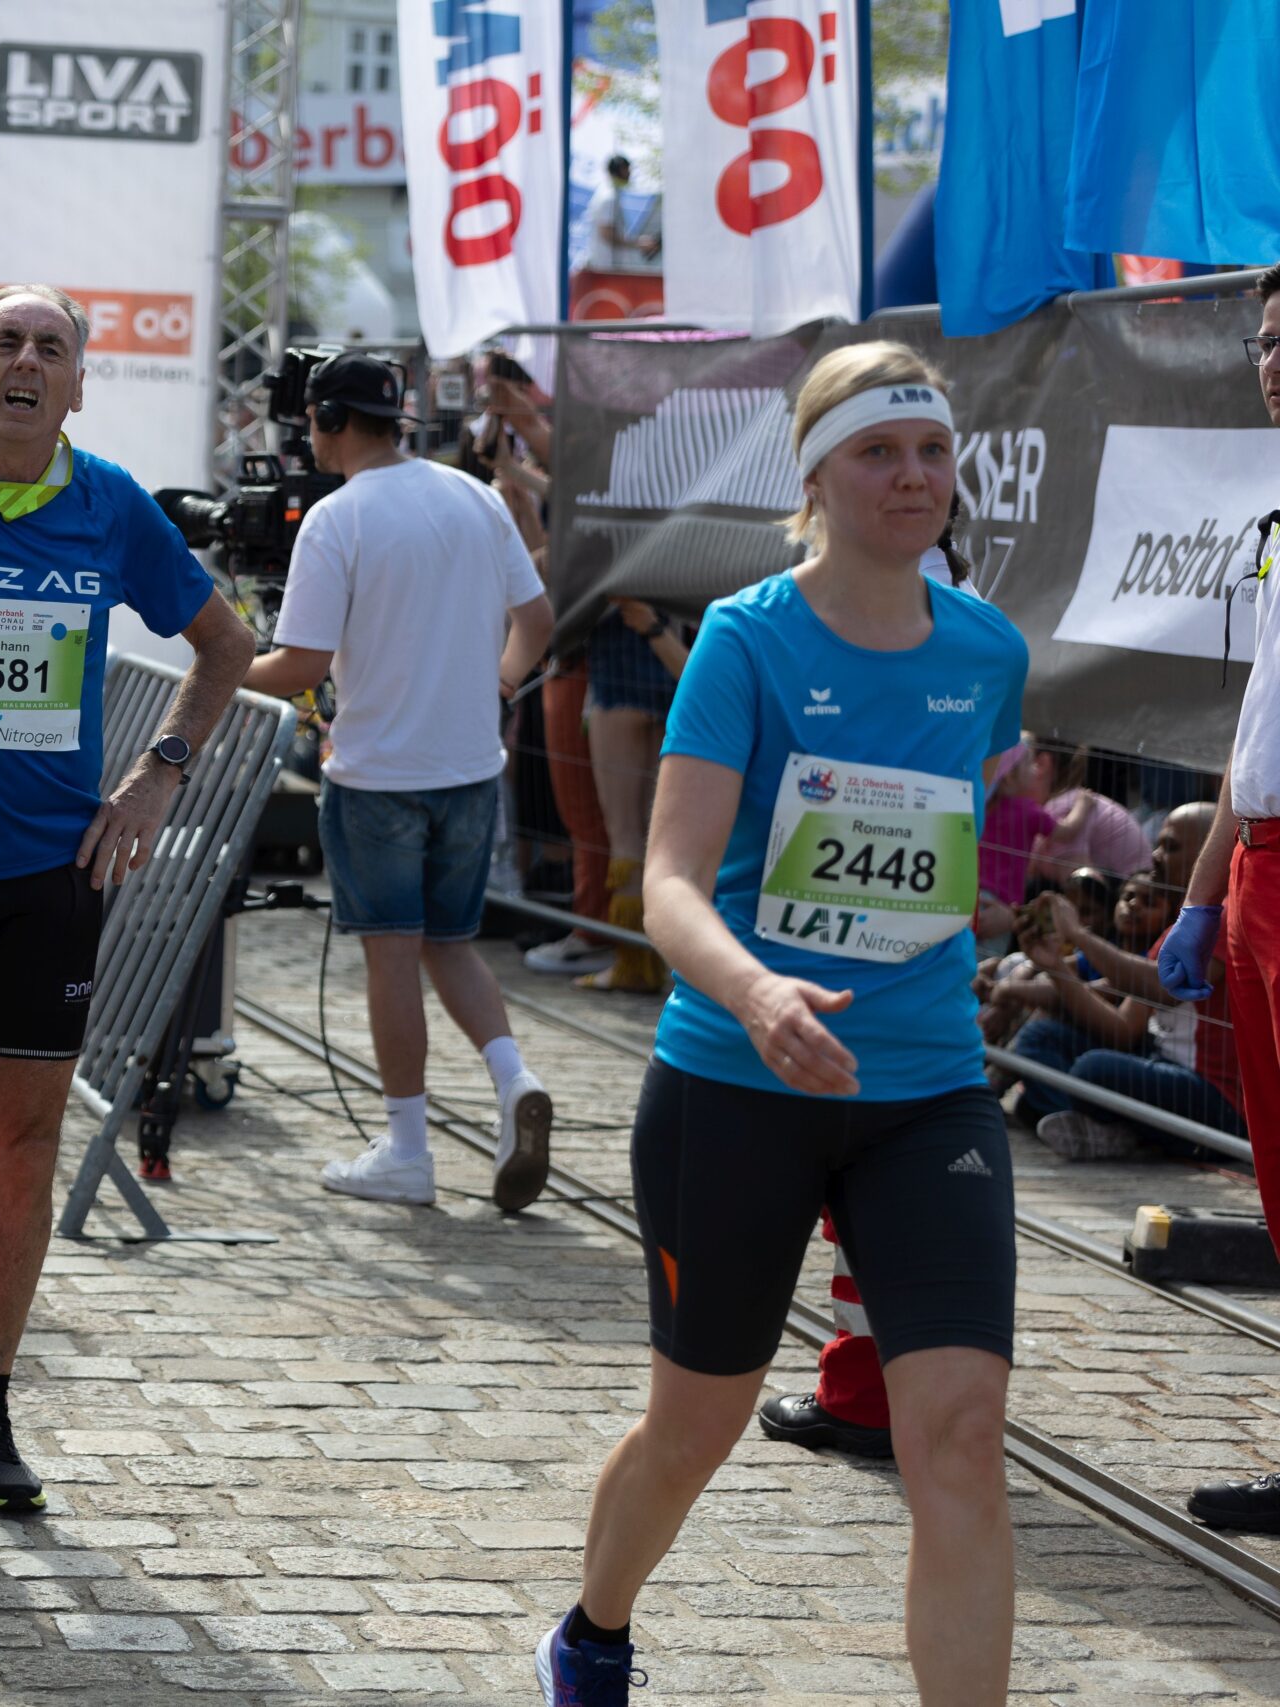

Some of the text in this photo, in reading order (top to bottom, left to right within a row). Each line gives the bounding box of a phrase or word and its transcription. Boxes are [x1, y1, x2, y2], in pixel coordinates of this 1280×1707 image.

[6, 51, 191, 105] LIVA
[6, 100, 191, 135] SPORT
[37, 570, 101, 596] AG
[927, 695, 975, 714] kokon
[844, 786, 867, 797] LINZ
[871, 788, 905, 800] DONAU
[863, 777, 904, 792] Oberbank
[843, 795, 904, 810] MARATHON
[852, 819, 912, 840] Romana
[811, 838, 937, 893] 2448
[777, 902, 932, 958] LAT Nitroge
